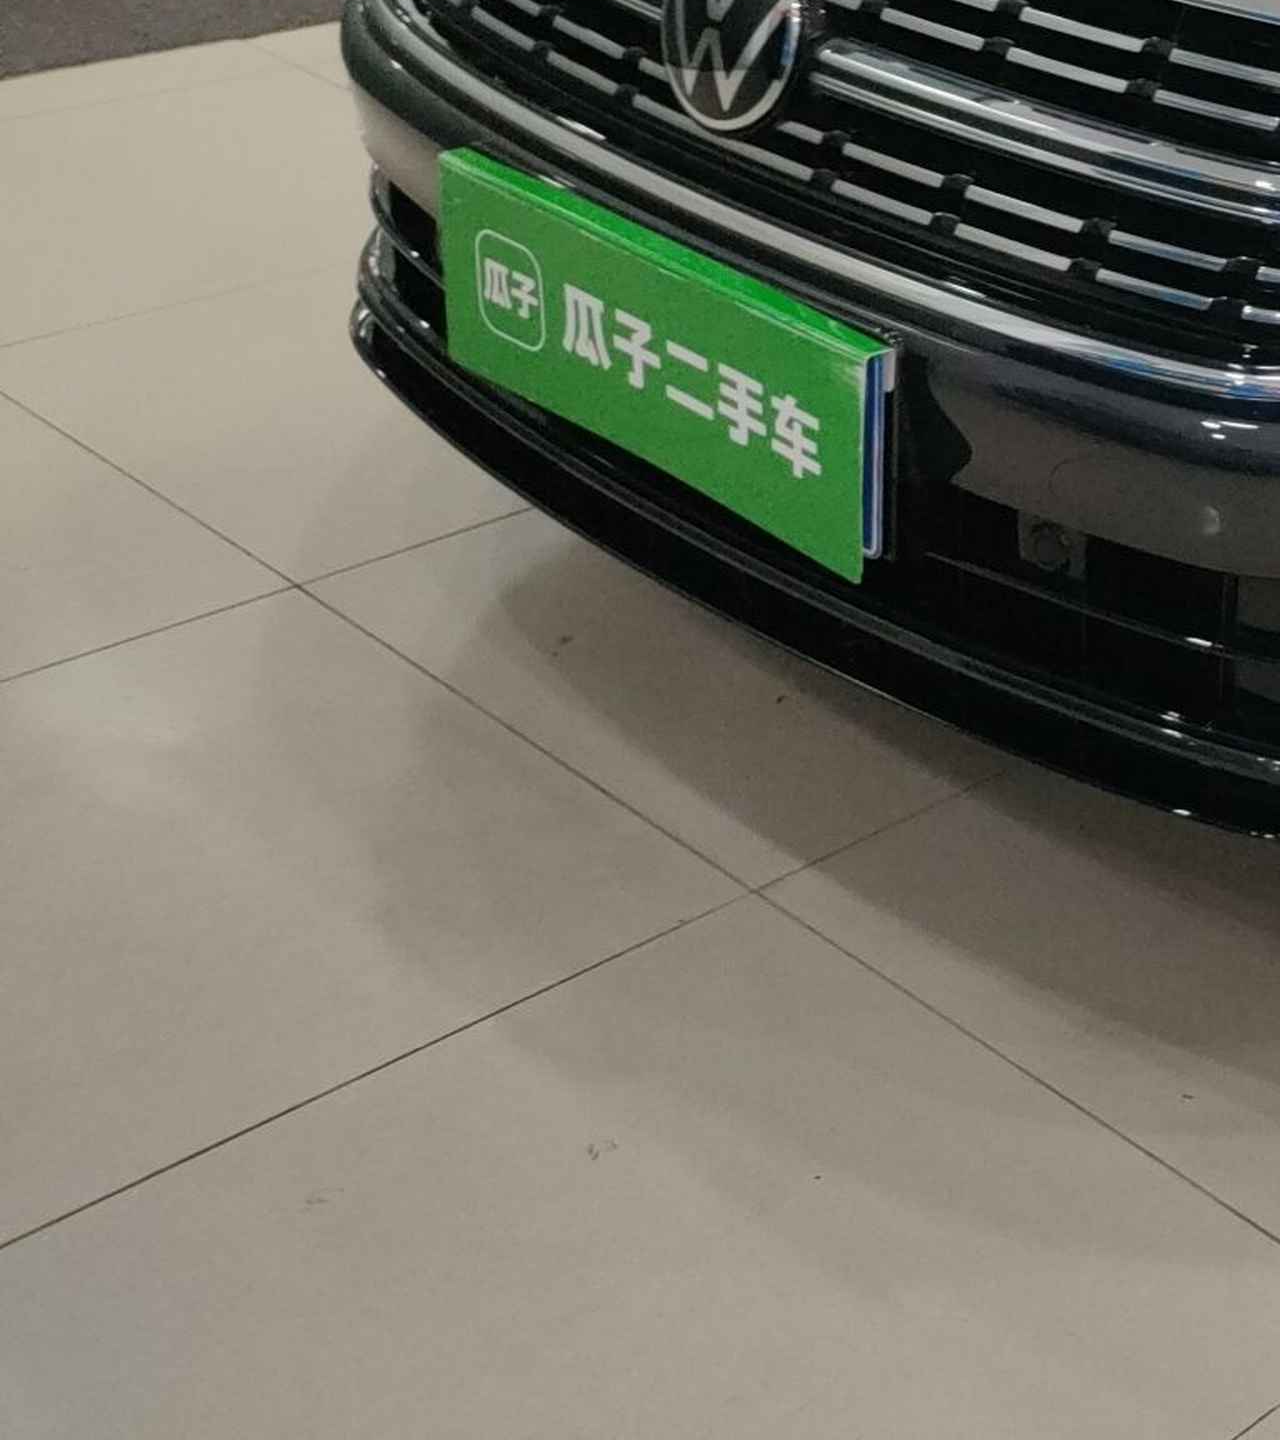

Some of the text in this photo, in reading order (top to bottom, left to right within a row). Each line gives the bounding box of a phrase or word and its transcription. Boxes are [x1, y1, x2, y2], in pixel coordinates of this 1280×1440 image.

[483, 257, 539, 320] 瓜子
[562, 282, 822, 479] 瓜子二手车
